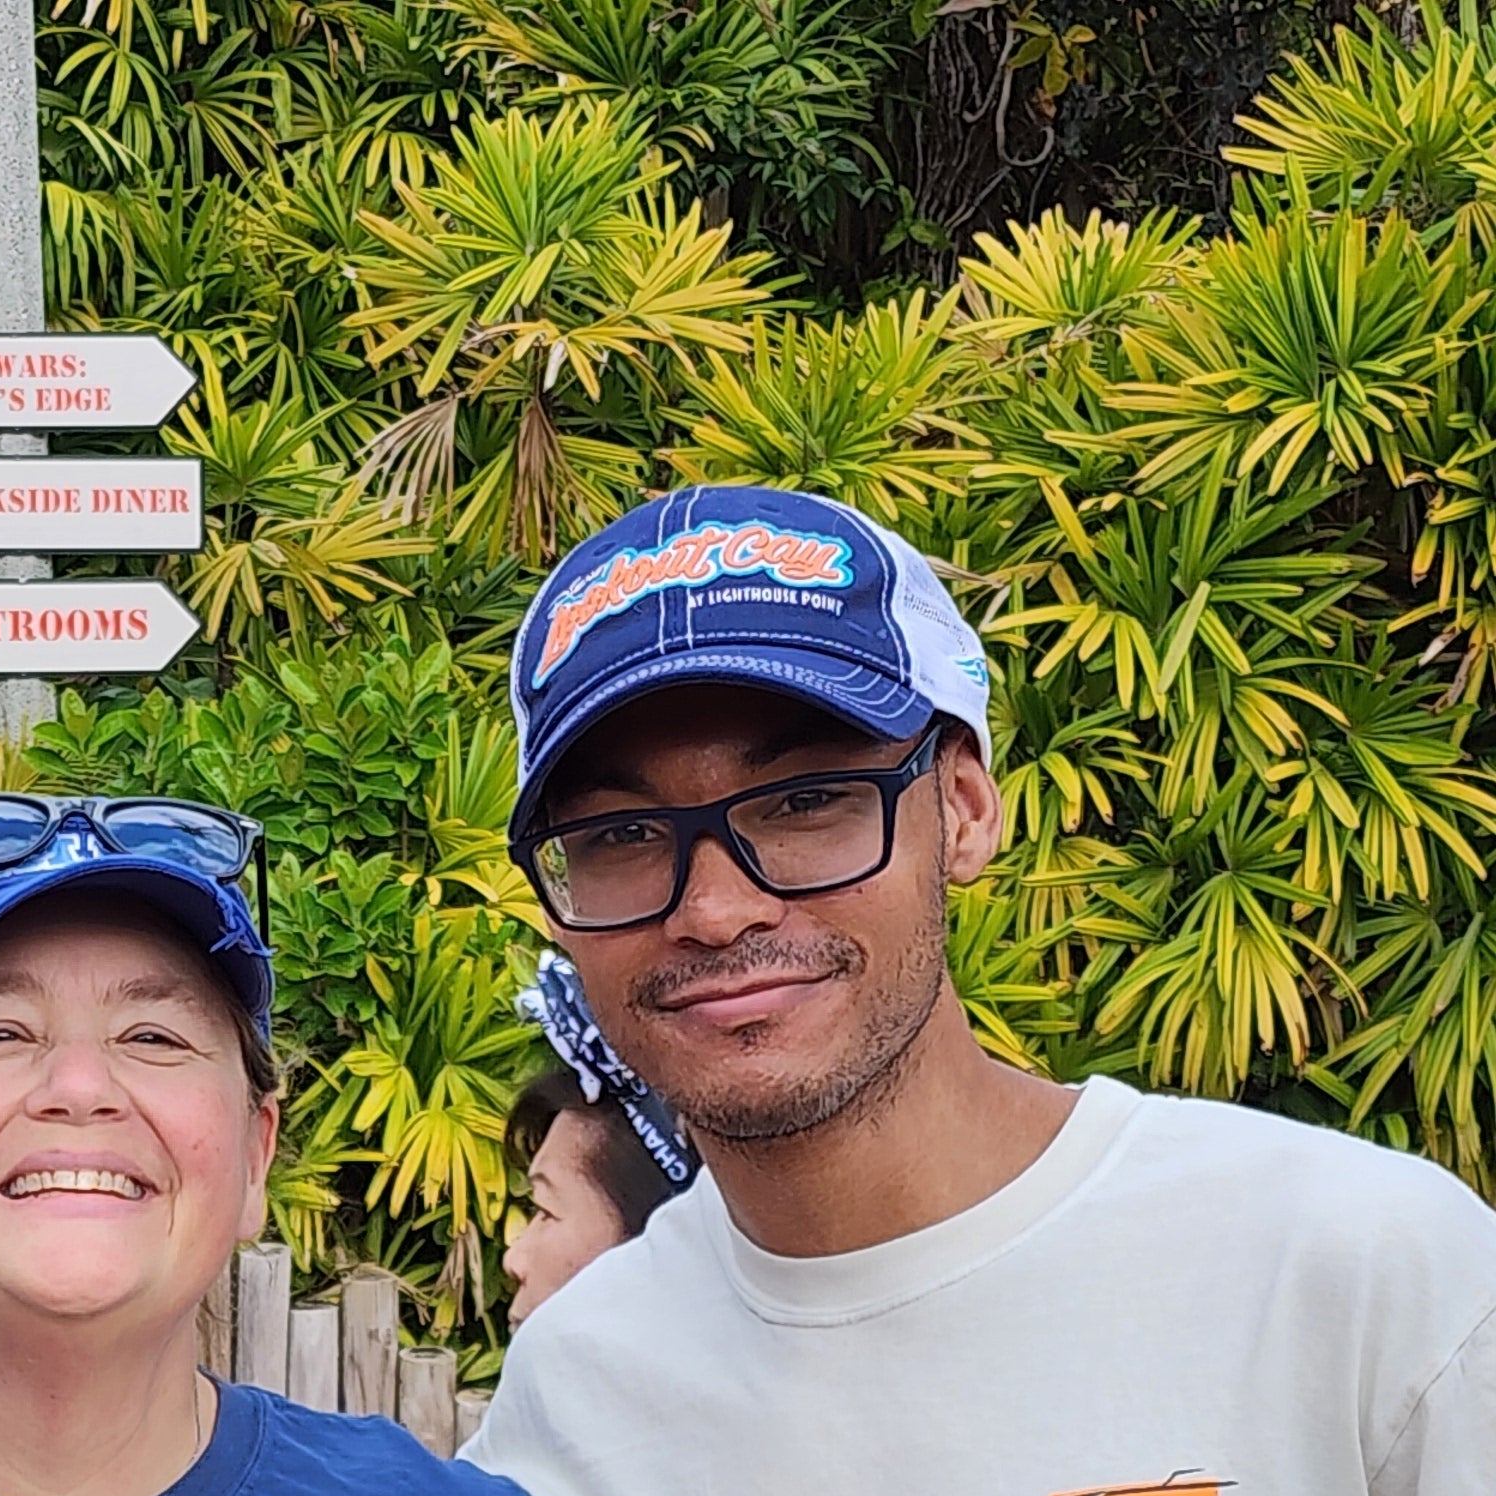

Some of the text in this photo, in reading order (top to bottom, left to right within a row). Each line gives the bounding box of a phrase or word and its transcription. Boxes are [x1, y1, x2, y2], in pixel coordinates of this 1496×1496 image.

[35, 387, 112, 412] EDGE
[91, 488, 190, 513] DINER
[723, 525, 841, 581] Cay
[707, 586, 799, 606] LIGHTHOUSE
[801, 588, 846, 617] POINT
